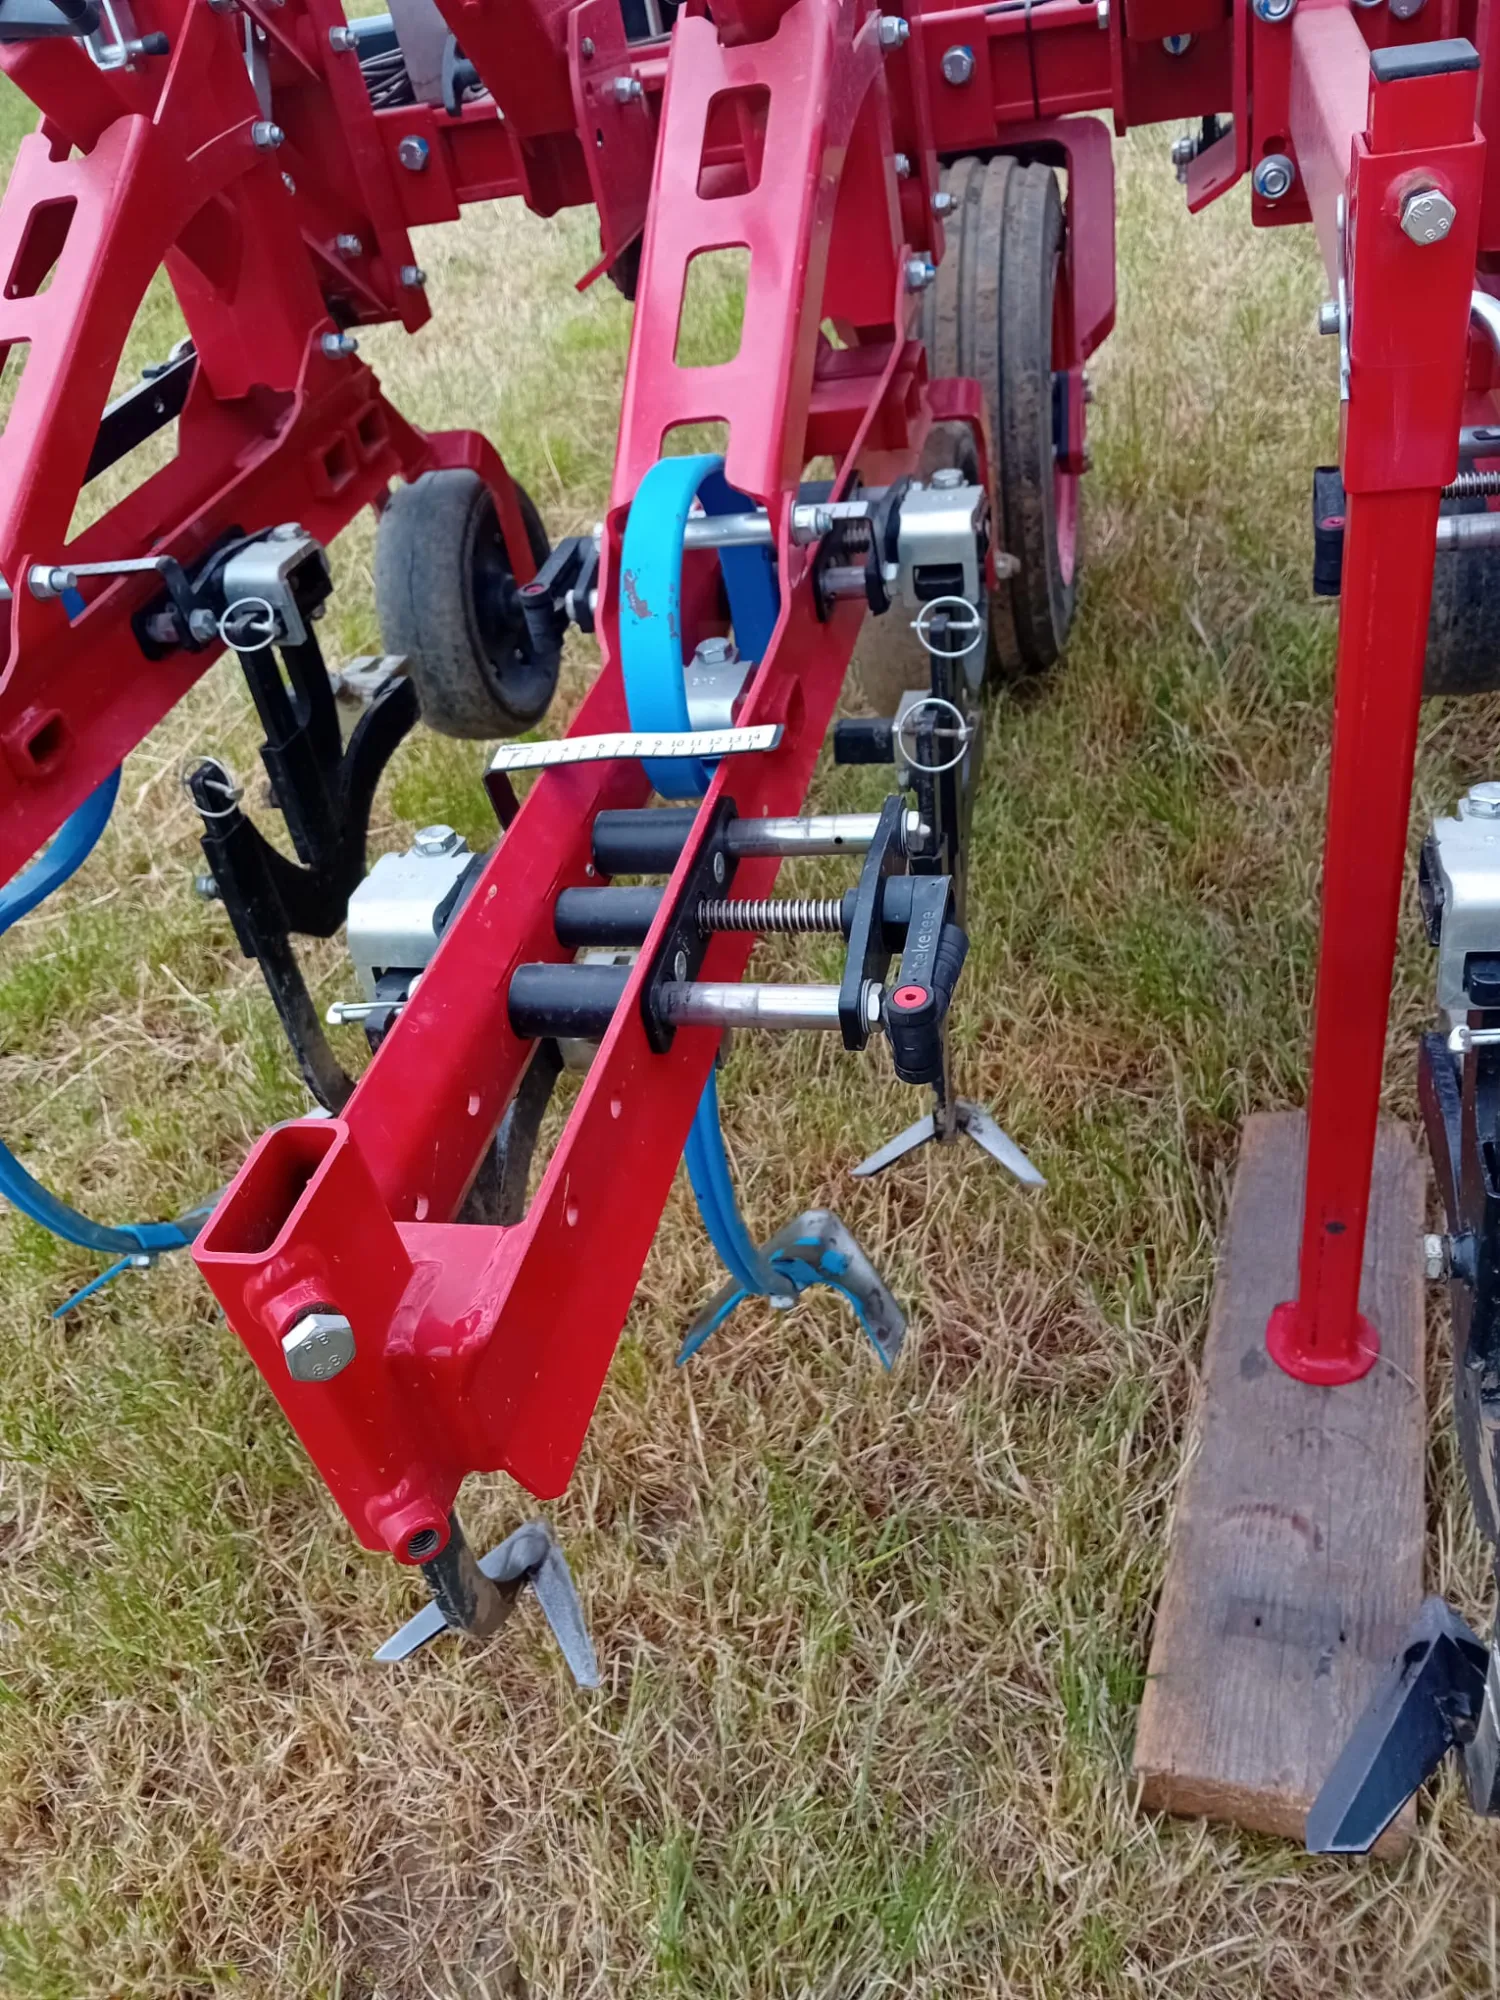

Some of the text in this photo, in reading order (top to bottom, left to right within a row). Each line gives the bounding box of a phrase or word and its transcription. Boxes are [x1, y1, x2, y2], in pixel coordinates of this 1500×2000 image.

[671, 740, 685, 748] 10
[748, 733, 761, 742] 14
[312, 1354, 342, 1378] 8.8
